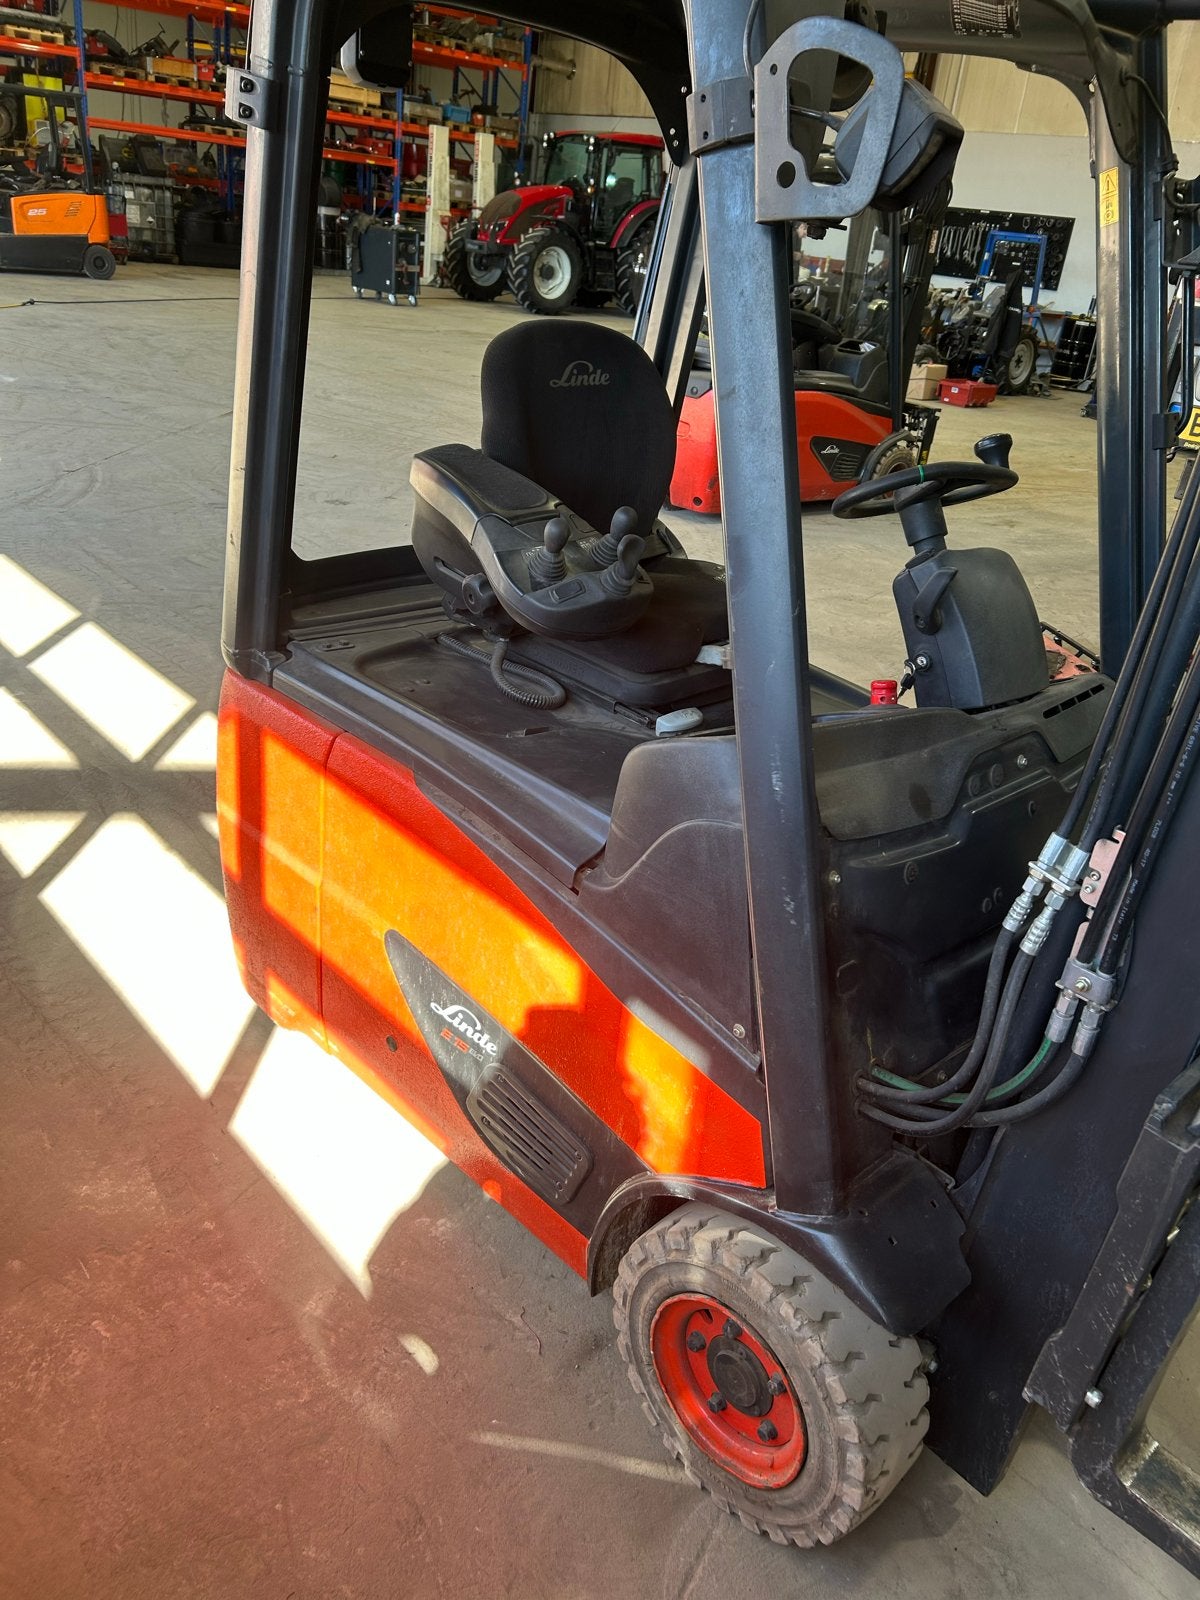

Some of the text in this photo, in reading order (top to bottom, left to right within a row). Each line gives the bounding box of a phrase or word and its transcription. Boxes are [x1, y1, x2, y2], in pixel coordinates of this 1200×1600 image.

[549, 360, 611, 388] Linde
[430, 1002, 497, 1056] Linde
[440, 1026, 454, 1042] E
